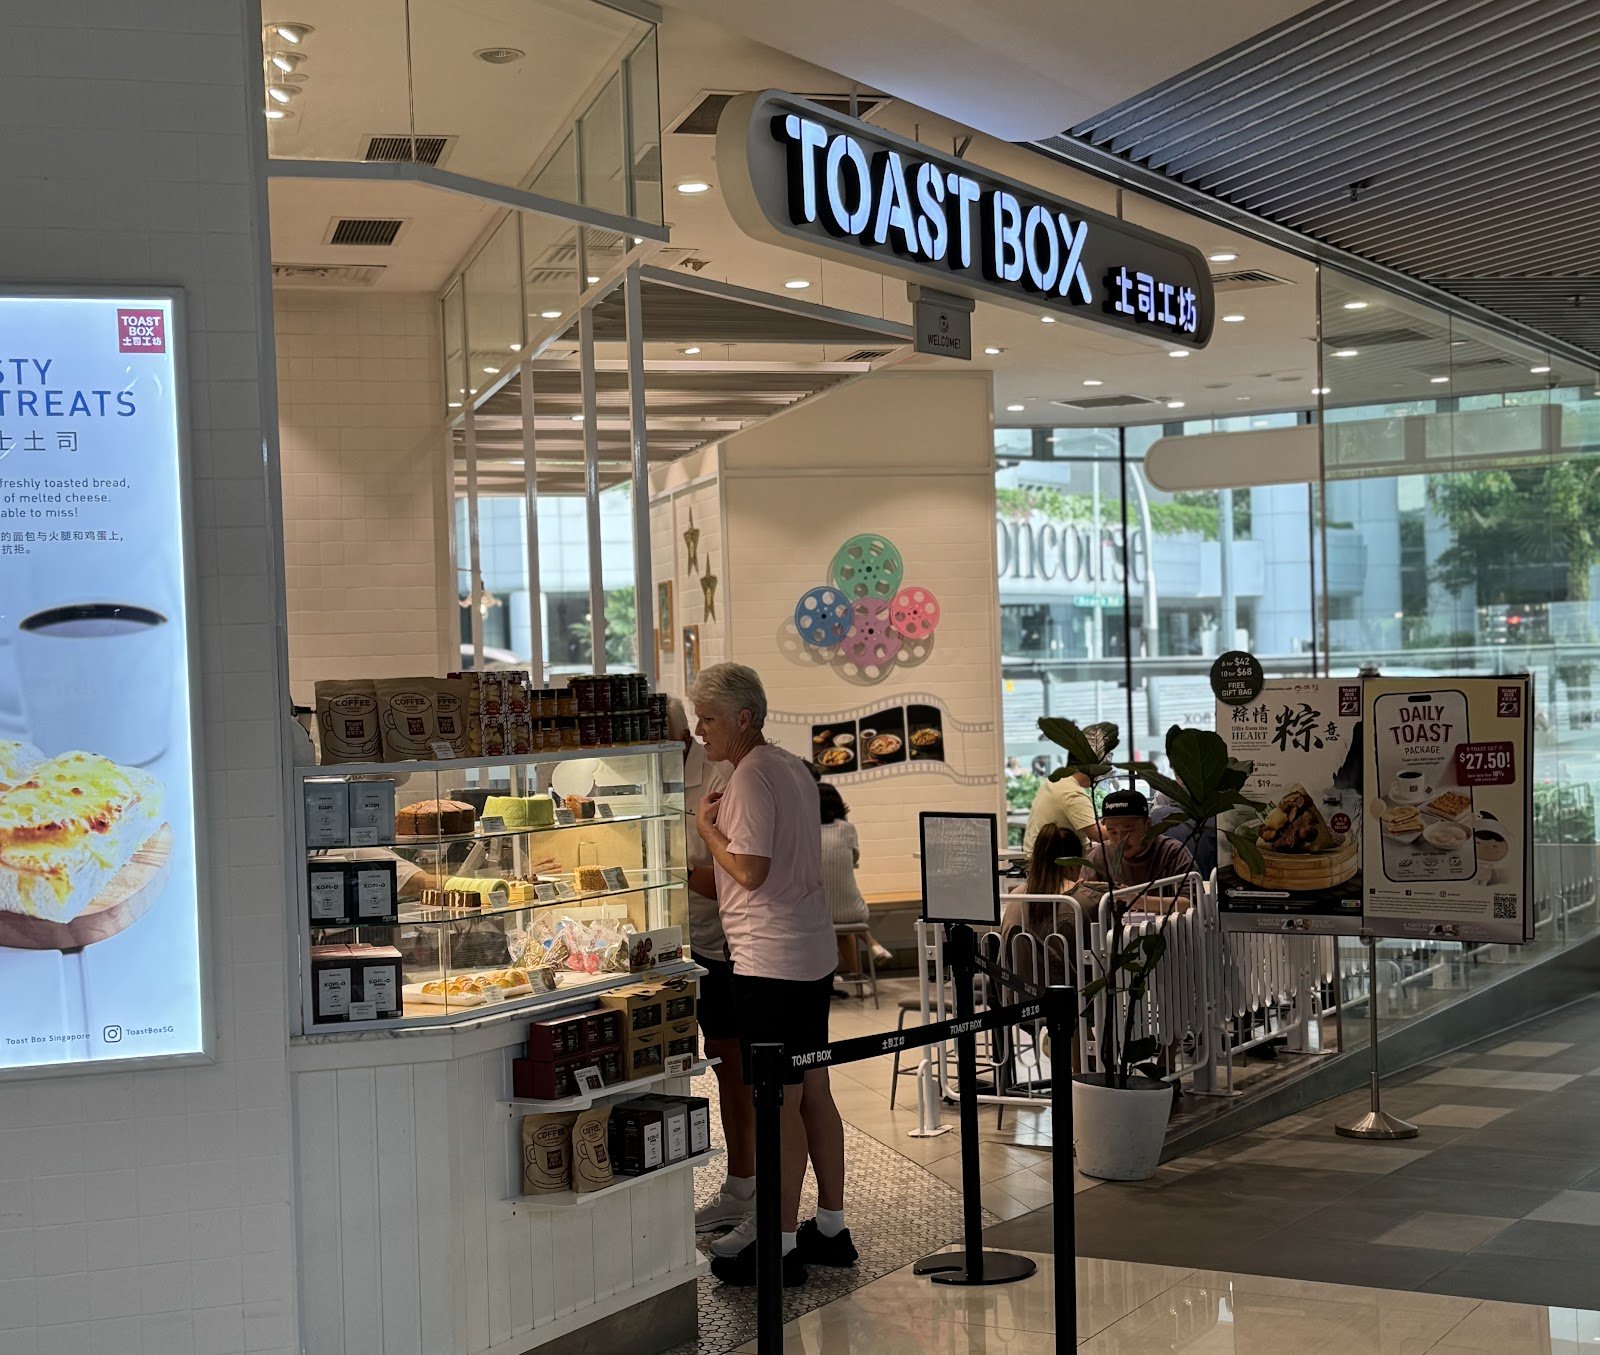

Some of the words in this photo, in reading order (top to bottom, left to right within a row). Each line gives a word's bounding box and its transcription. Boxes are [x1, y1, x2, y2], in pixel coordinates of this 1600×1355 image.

[785, 113, 980, 269] TOAST
[993, 190, 1093, 304] BOX
[1115, 266, 1197, 334] 土司工坊
[121, 316, 162, 326] TOAST
[128, 326, 155, 337] BOX
[122, 337, 162, 347] 土司工坊
[927, 334, 961, 350] WELCOME!
[0, 358, 53, 386] TY
[44, 478, 89, 488] toasted
[92, 477, 130, 489] bread,
[4, 493, 16, 503] of
[19, 493, 62, 503] melted
[65, 493, 112, 503] cheese.
[30, 508, 42, 518] to
[45, 507, 79, 517] miss!
[1234, 657, 1250, 667] $42
[1221, 670, 1228, 678] 10
[1236, 667, 1252, 677] $68
[1222, 689, 1238, 697] GIFT
[1238, 688, 1252, 696] BAG
[394, 698, 426, 706] COFFEE
[1400, 706, 1445, 722] DAILY
[1232, 732, 1268, 740] HEART
[1389, 723, 1453, 744] TOAST
[1404, 746, 1441, 755] PACKAGE
[1460, 752, 1510, 770] $27.50!
[1258, 780, 1270, 788] $19
[126, 1026, 174, 1036] ToastBoxSG
[950, 1022, 970, 1035] TOAST
[970, 1019, 982, 1031] BOX
[49, 1033, 91, 1043] Singapore
[792, 1052, 816, 1067] TOAST
[816, 1049, 832, 1062] BOX
